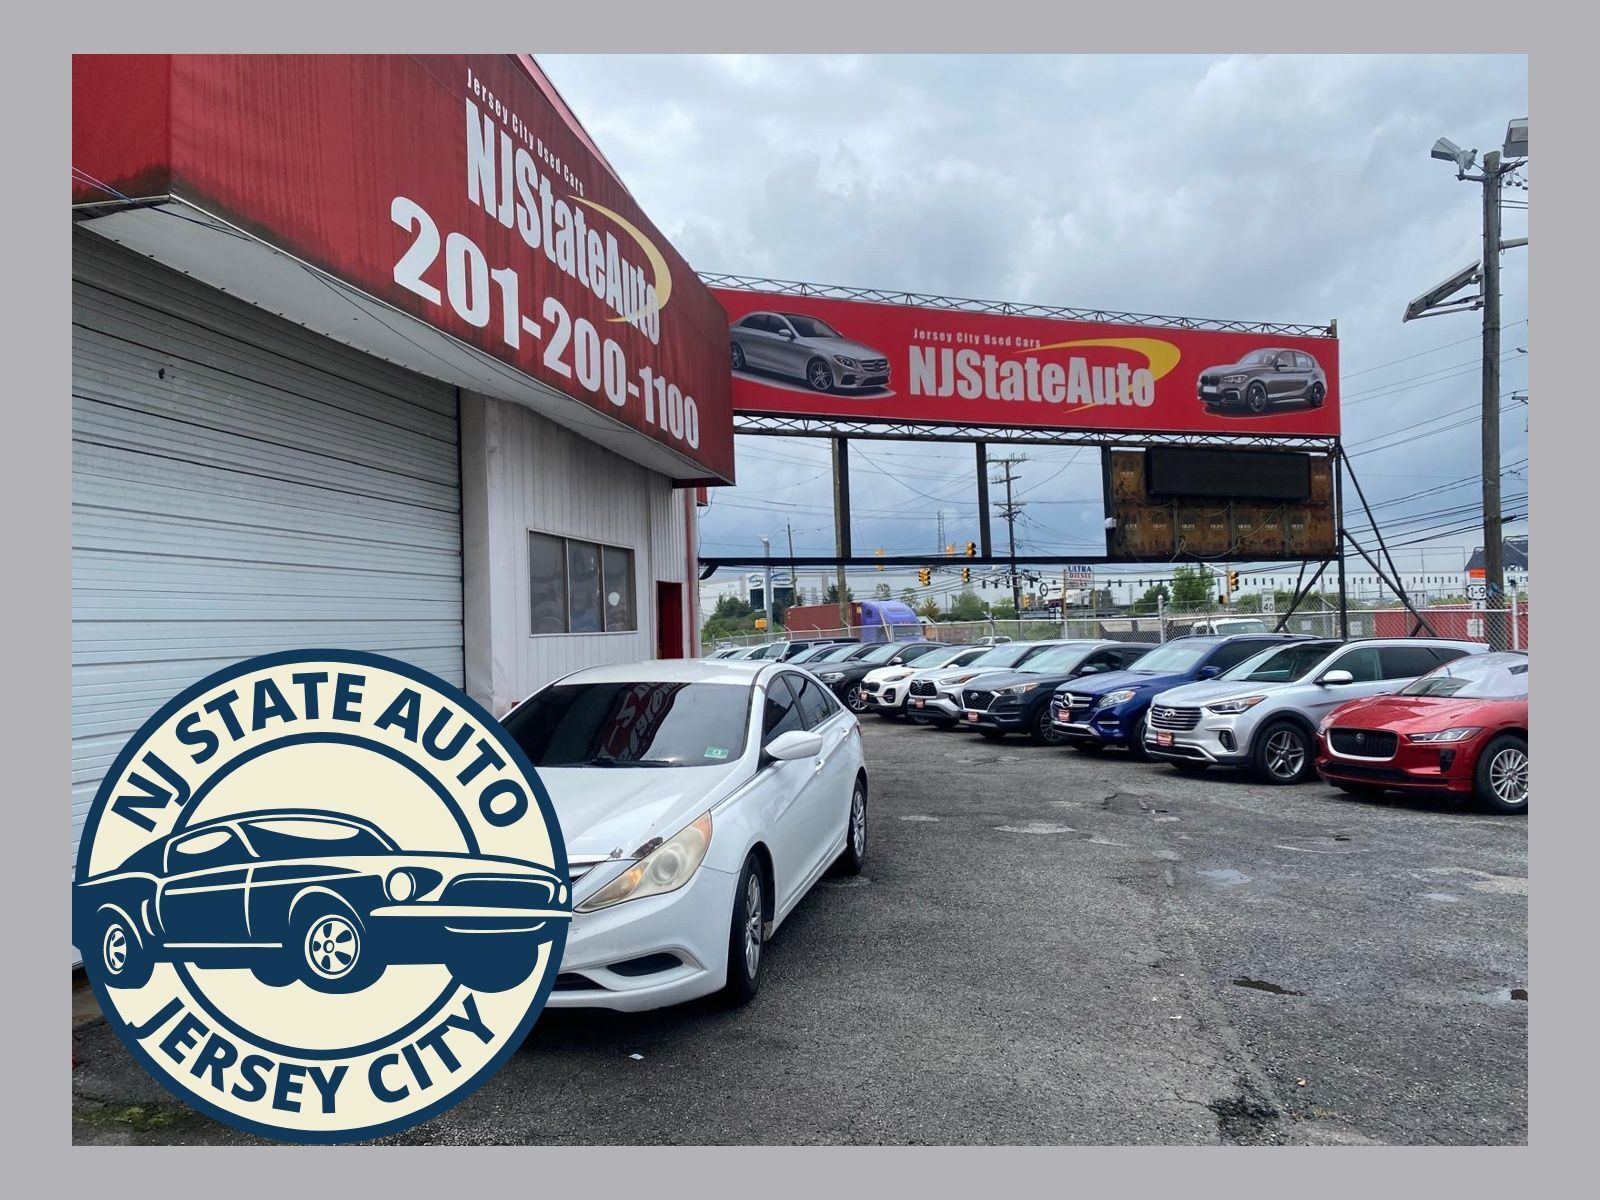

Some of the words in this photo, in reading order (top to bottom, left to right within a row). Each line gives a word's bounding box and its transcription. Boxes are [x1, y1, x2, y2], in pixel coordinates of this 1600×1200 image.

[467, 67, 508, 125] Jersey
[512, 113, 534, 150] City
[537, 138, 561, 175] Used
[563, 164, 584, 197] Cars
[466, 97, 660, 346] NJStateAuto
[390, 196, 699, 450] 201-200-1100
[913, 328, 952, 343] Jersey
[956, 331, 980, 346] City
[983, 334, 1012, 347] Used
[1015, 336, 1041, 349] Cars
[908, 344, 1155, 408] NJStateAuto
[1068, 565, 1092, 573] ULTRA
